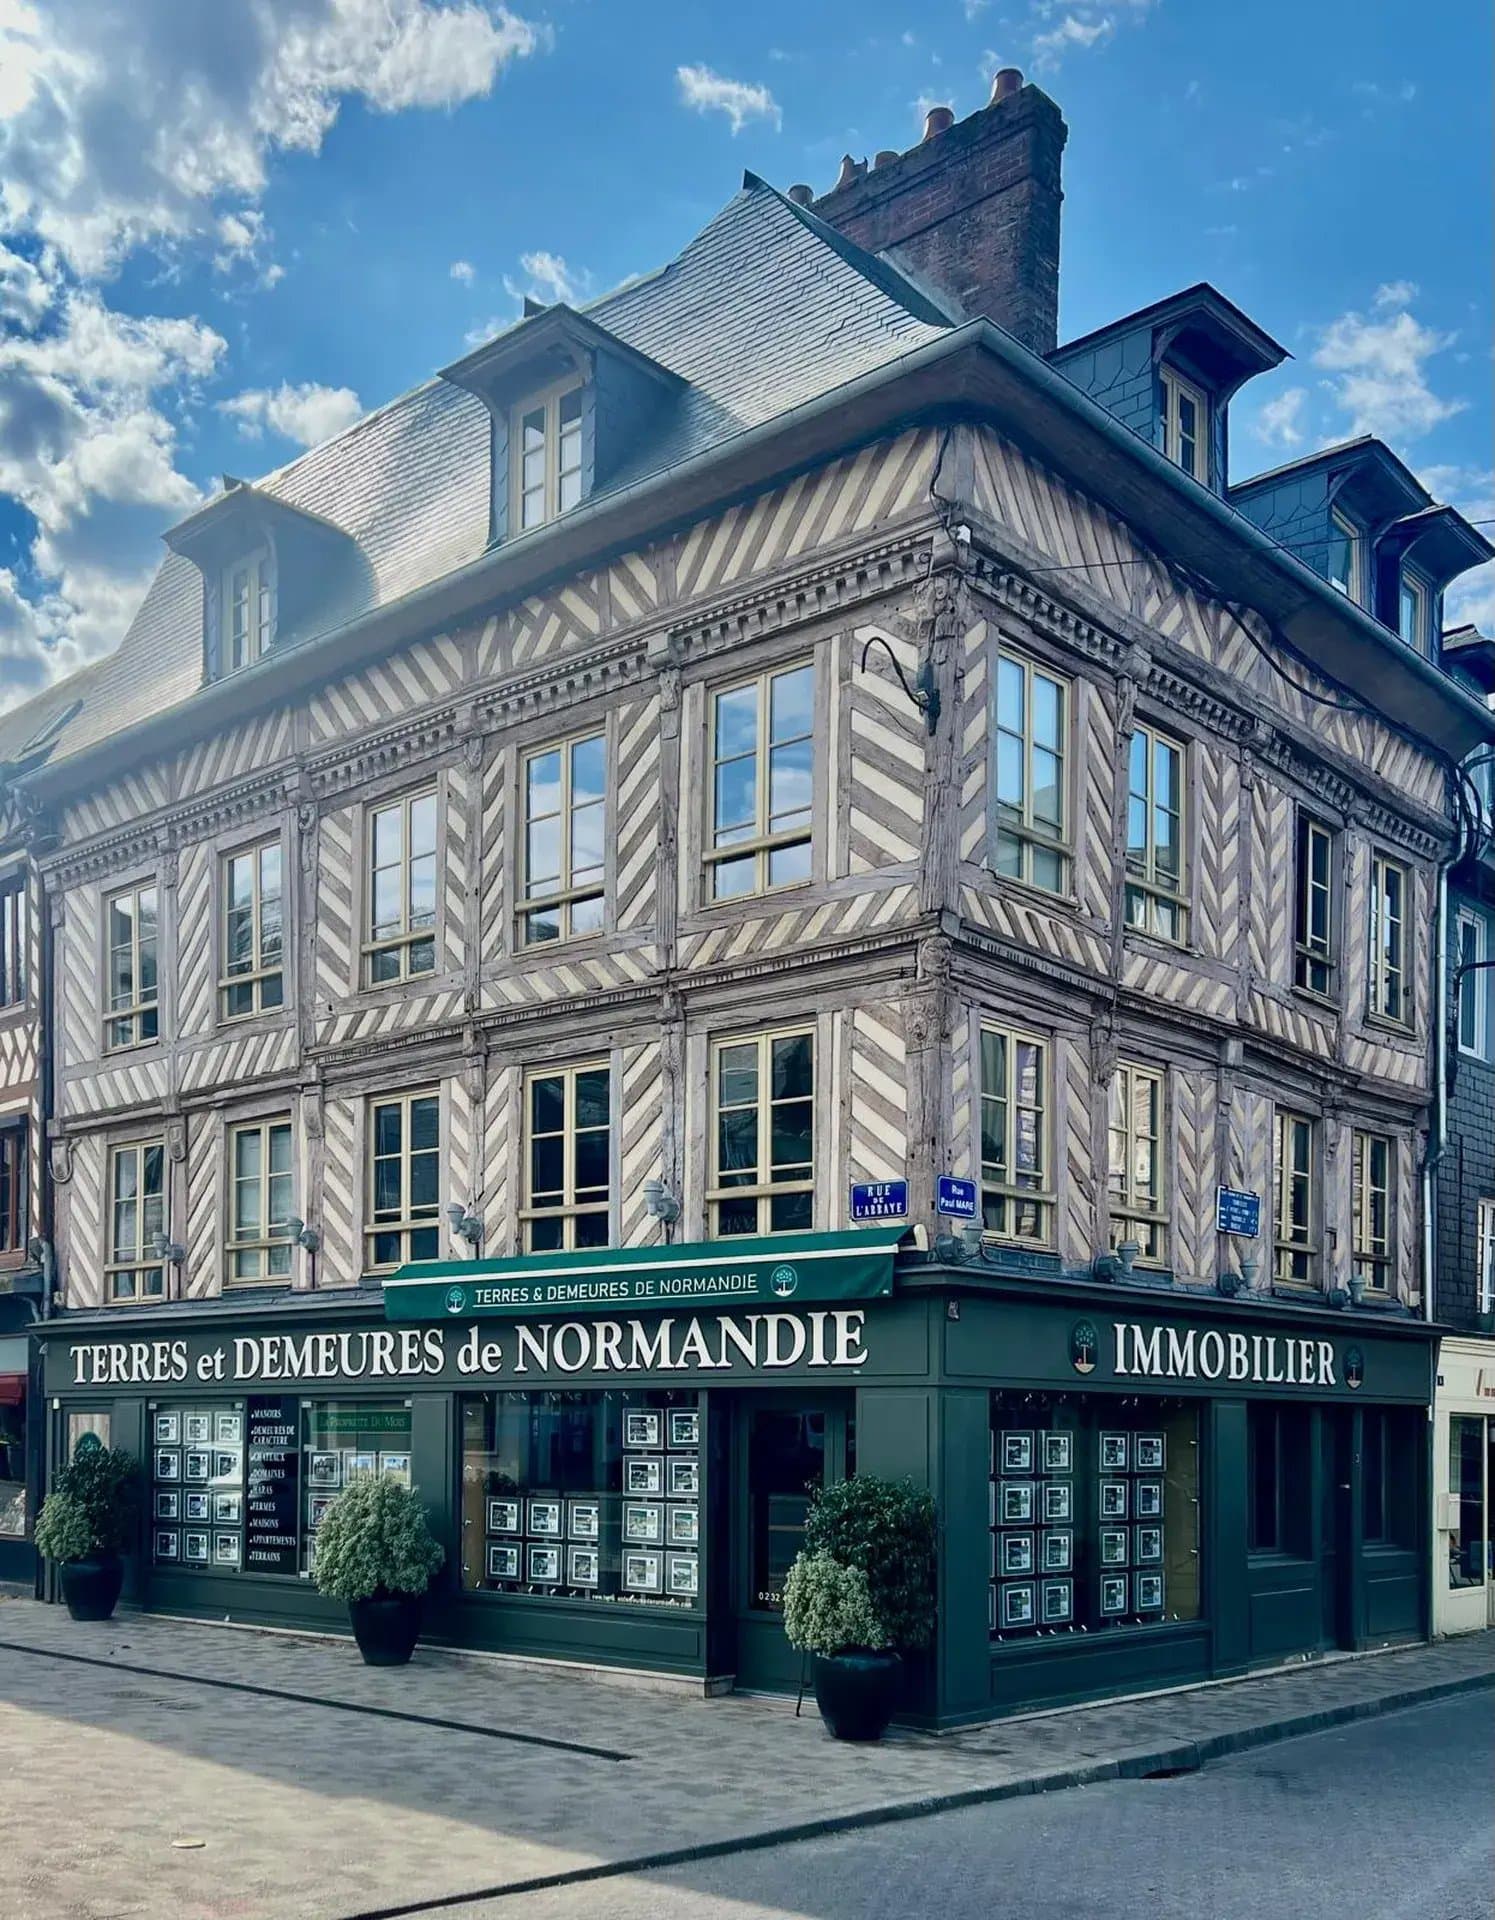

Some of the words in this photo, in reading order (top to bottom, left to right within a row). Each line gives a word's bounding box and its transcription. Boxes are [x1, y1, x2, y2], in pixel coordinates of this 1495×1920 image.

[867, 1184, 891, 1197] RUE
[951, 1184, 964, 1196] Rue
[940, 1197, 955, 1208] Paul
[856, 1202, 903, 1217] L'ABBAYE
[475, 1287, 529, 1304] TERRES
[533, 1290, 543, 1302] &
[547, 1281, 629, 1300] DEMEURES
[635, 1280, 655, 1296] DE
[659, 1273, 759, 1294] NORMANDIE
[69, 1340, 188, 1384] TERRES
[196, 1346, 226, 1381] et
[232, 1328, 445, 1380] DEMEURES
[456, 1324, 502, 1373] de
[513, 1309, 869, 1373] NORMANDIE
[1112, 1322, 1337, 1386] IMMOBILIER
[252, 1501, 276, 1512] FERMES
[252, 1518, 279, 1528] MAISONS
[251, 1551, 281, 1562] TERRAINS
